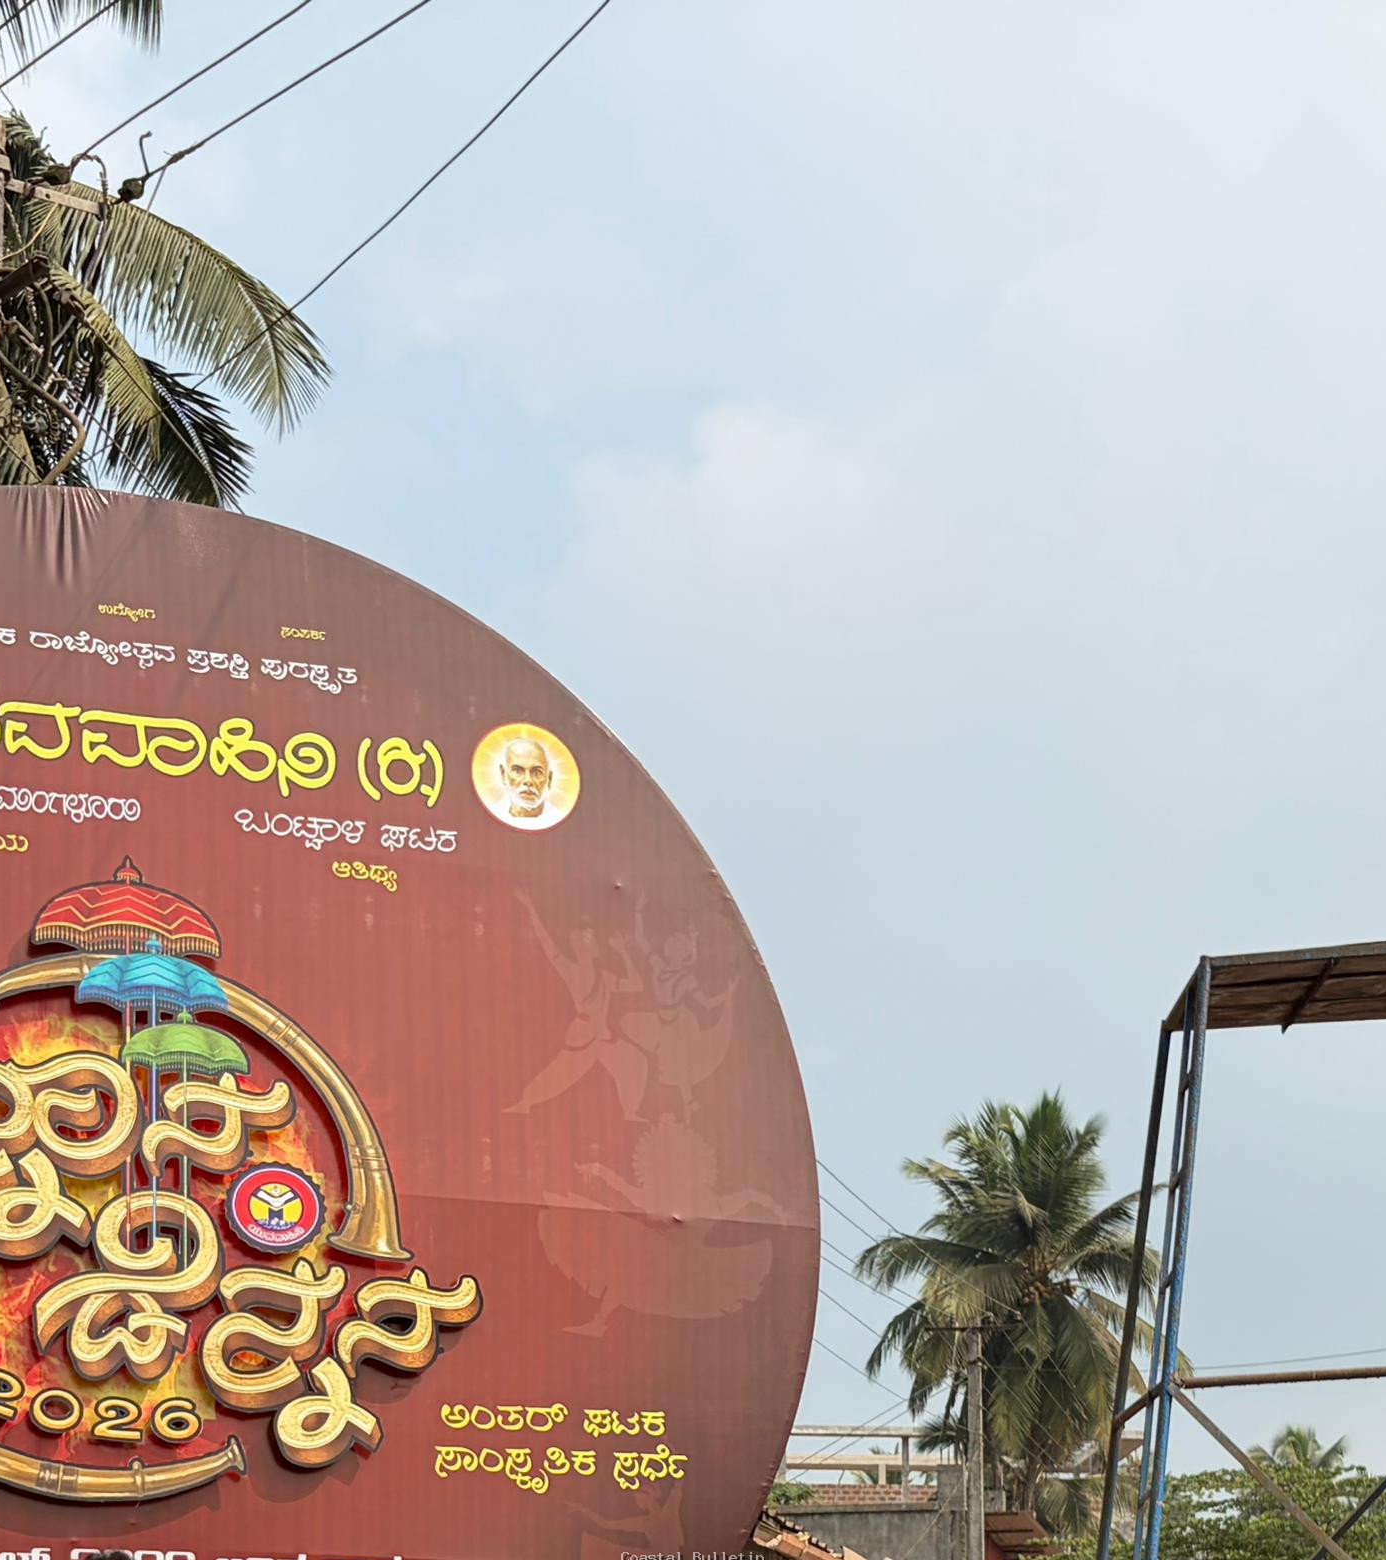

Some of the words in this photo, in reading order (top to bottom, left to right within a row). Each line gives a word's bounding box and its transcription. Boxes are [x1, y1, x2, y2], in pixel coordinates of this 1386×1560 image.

[29, 631, 176, 669] ರಾಜ್ಯೋತ್ಸವ
[187, 648, 251, 680] ಪ್ರಶಸ್ತಿ
[260, 657, 359, 695] ಪುರಸ್ಕೃತ
[234, 808, 366, 851] ಬಂಟ್ವಾಳ
[380, 824, 458, 853] ಘಟಕ
[331, 860, 399, 892] ಆತಿಥ್ಯ
[440, 1402, 569, 1434] ಅಂತರ್
[583, 1408, 666, 1438] ಘಟಕ
[434, 1445, 598, 1494] ಸಾಂಸ್ಕೃತಿಕ
[613, 1443, 689, 1491] ಸ್ಪರ್ಧೆ
